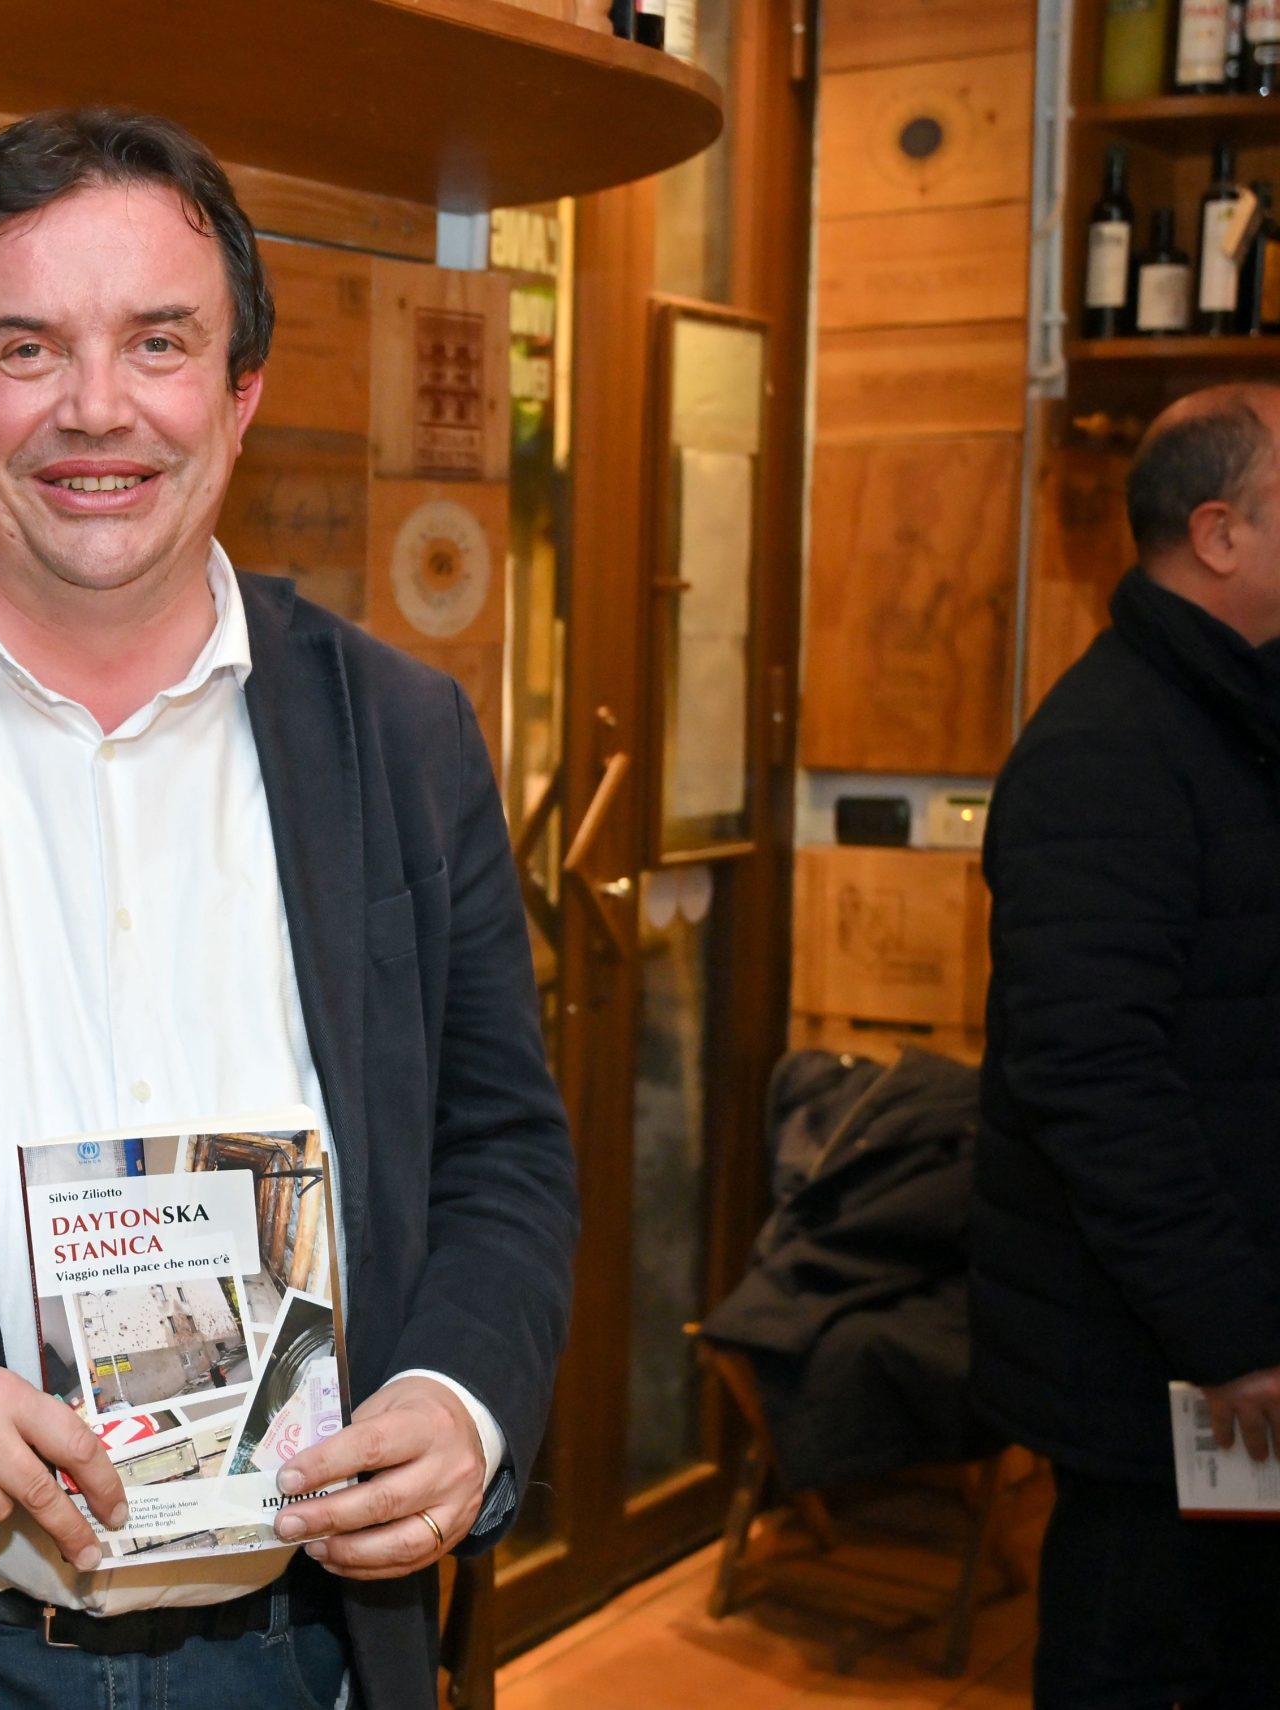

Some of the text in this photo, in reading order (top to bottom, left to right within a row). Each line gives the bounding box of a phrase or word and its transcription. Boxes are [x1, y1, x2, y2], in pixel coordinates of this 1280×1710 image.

[49, 1188, 122, 1204] Silvio Ziliotto
[52, 1203, 210, 1236] DAYTONSKA
[54, 1234, 164, 1265] STANICA
[56, 1267, 99, 1282] Viaggio
[102, 1264, 130, 1277] nella
[133, 1263, 161, 1277] pace
[163, 1258, 185, 1271] che
[187, 1256, 210, 1268] non
[130, 1504, 150, 1513] Diana
[128, 1521, 153, 1530] Roberto
